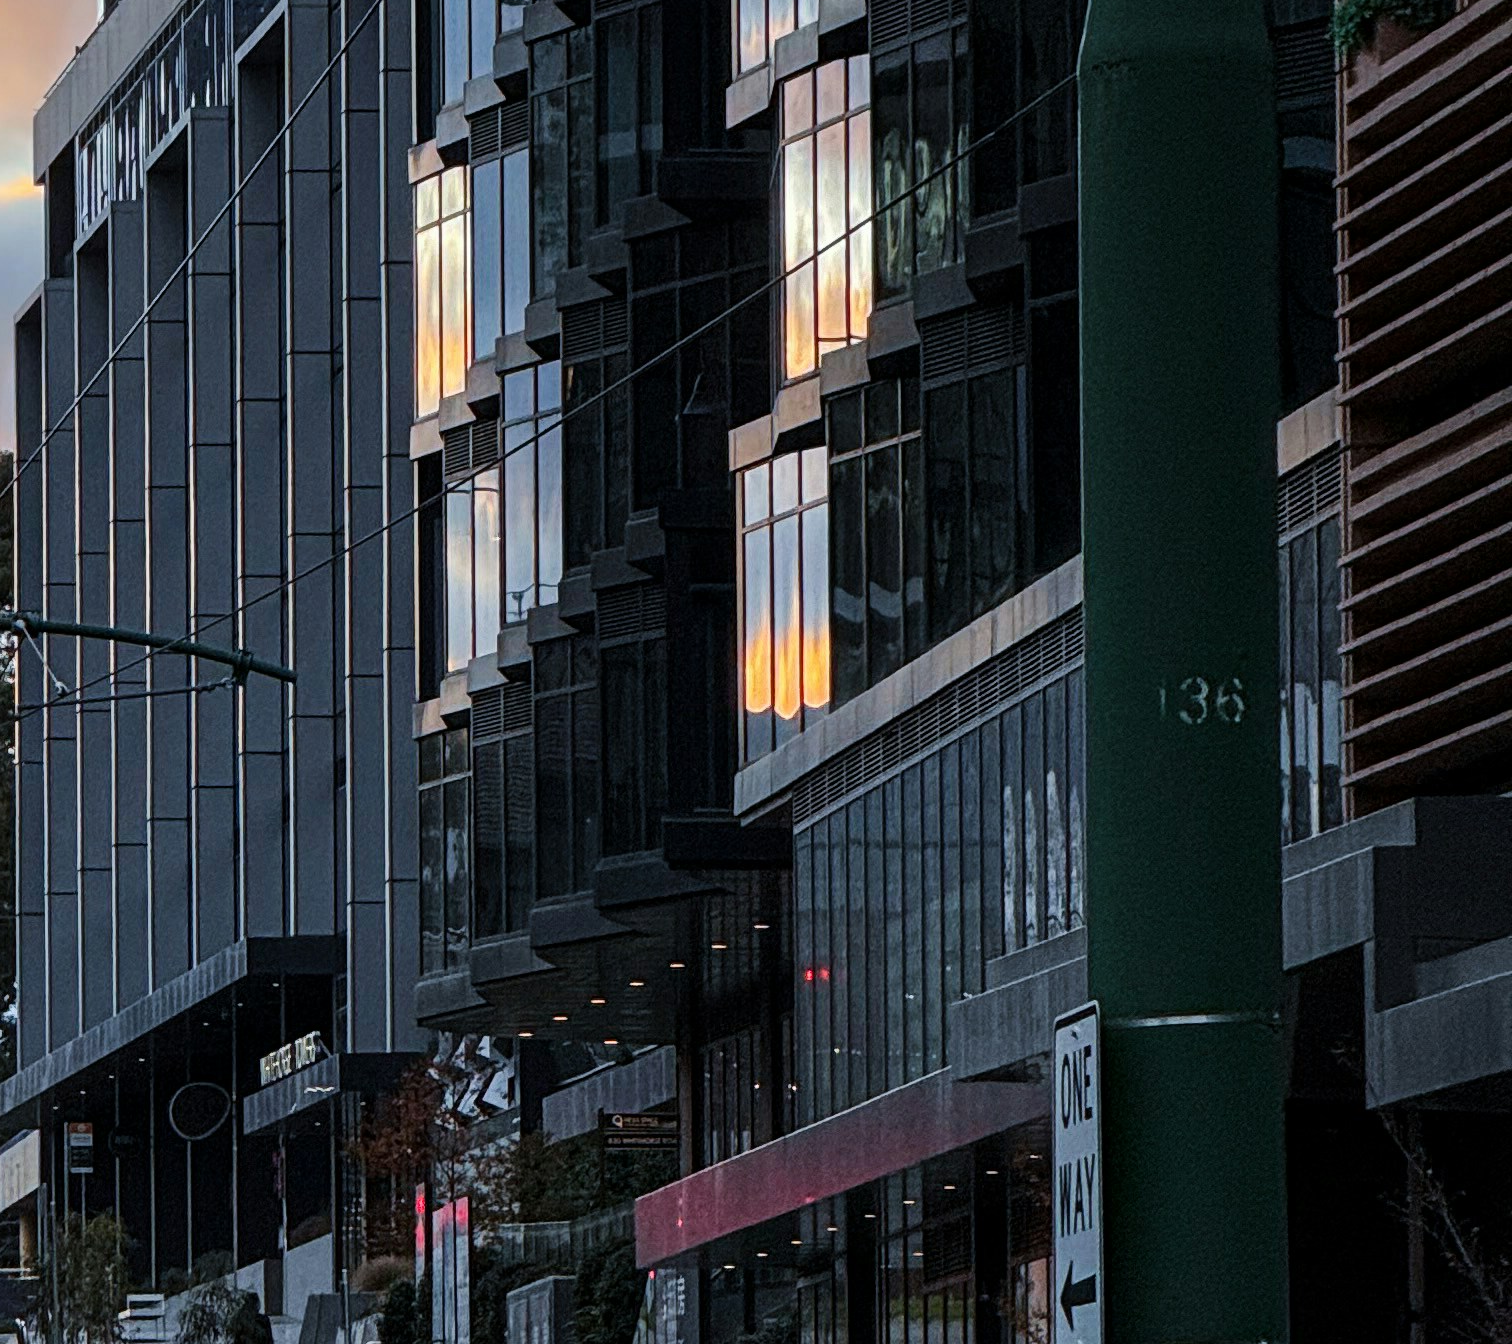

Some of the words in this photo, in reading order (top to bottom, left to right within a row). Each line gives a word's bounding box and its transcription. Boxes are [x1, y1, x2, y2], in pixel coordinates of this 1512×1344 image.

[1159, 676, 1245, 724] 136
[1061, 1044, 1093, 1129] ONE
[1059, 1153, 1096, 1238] WAY
